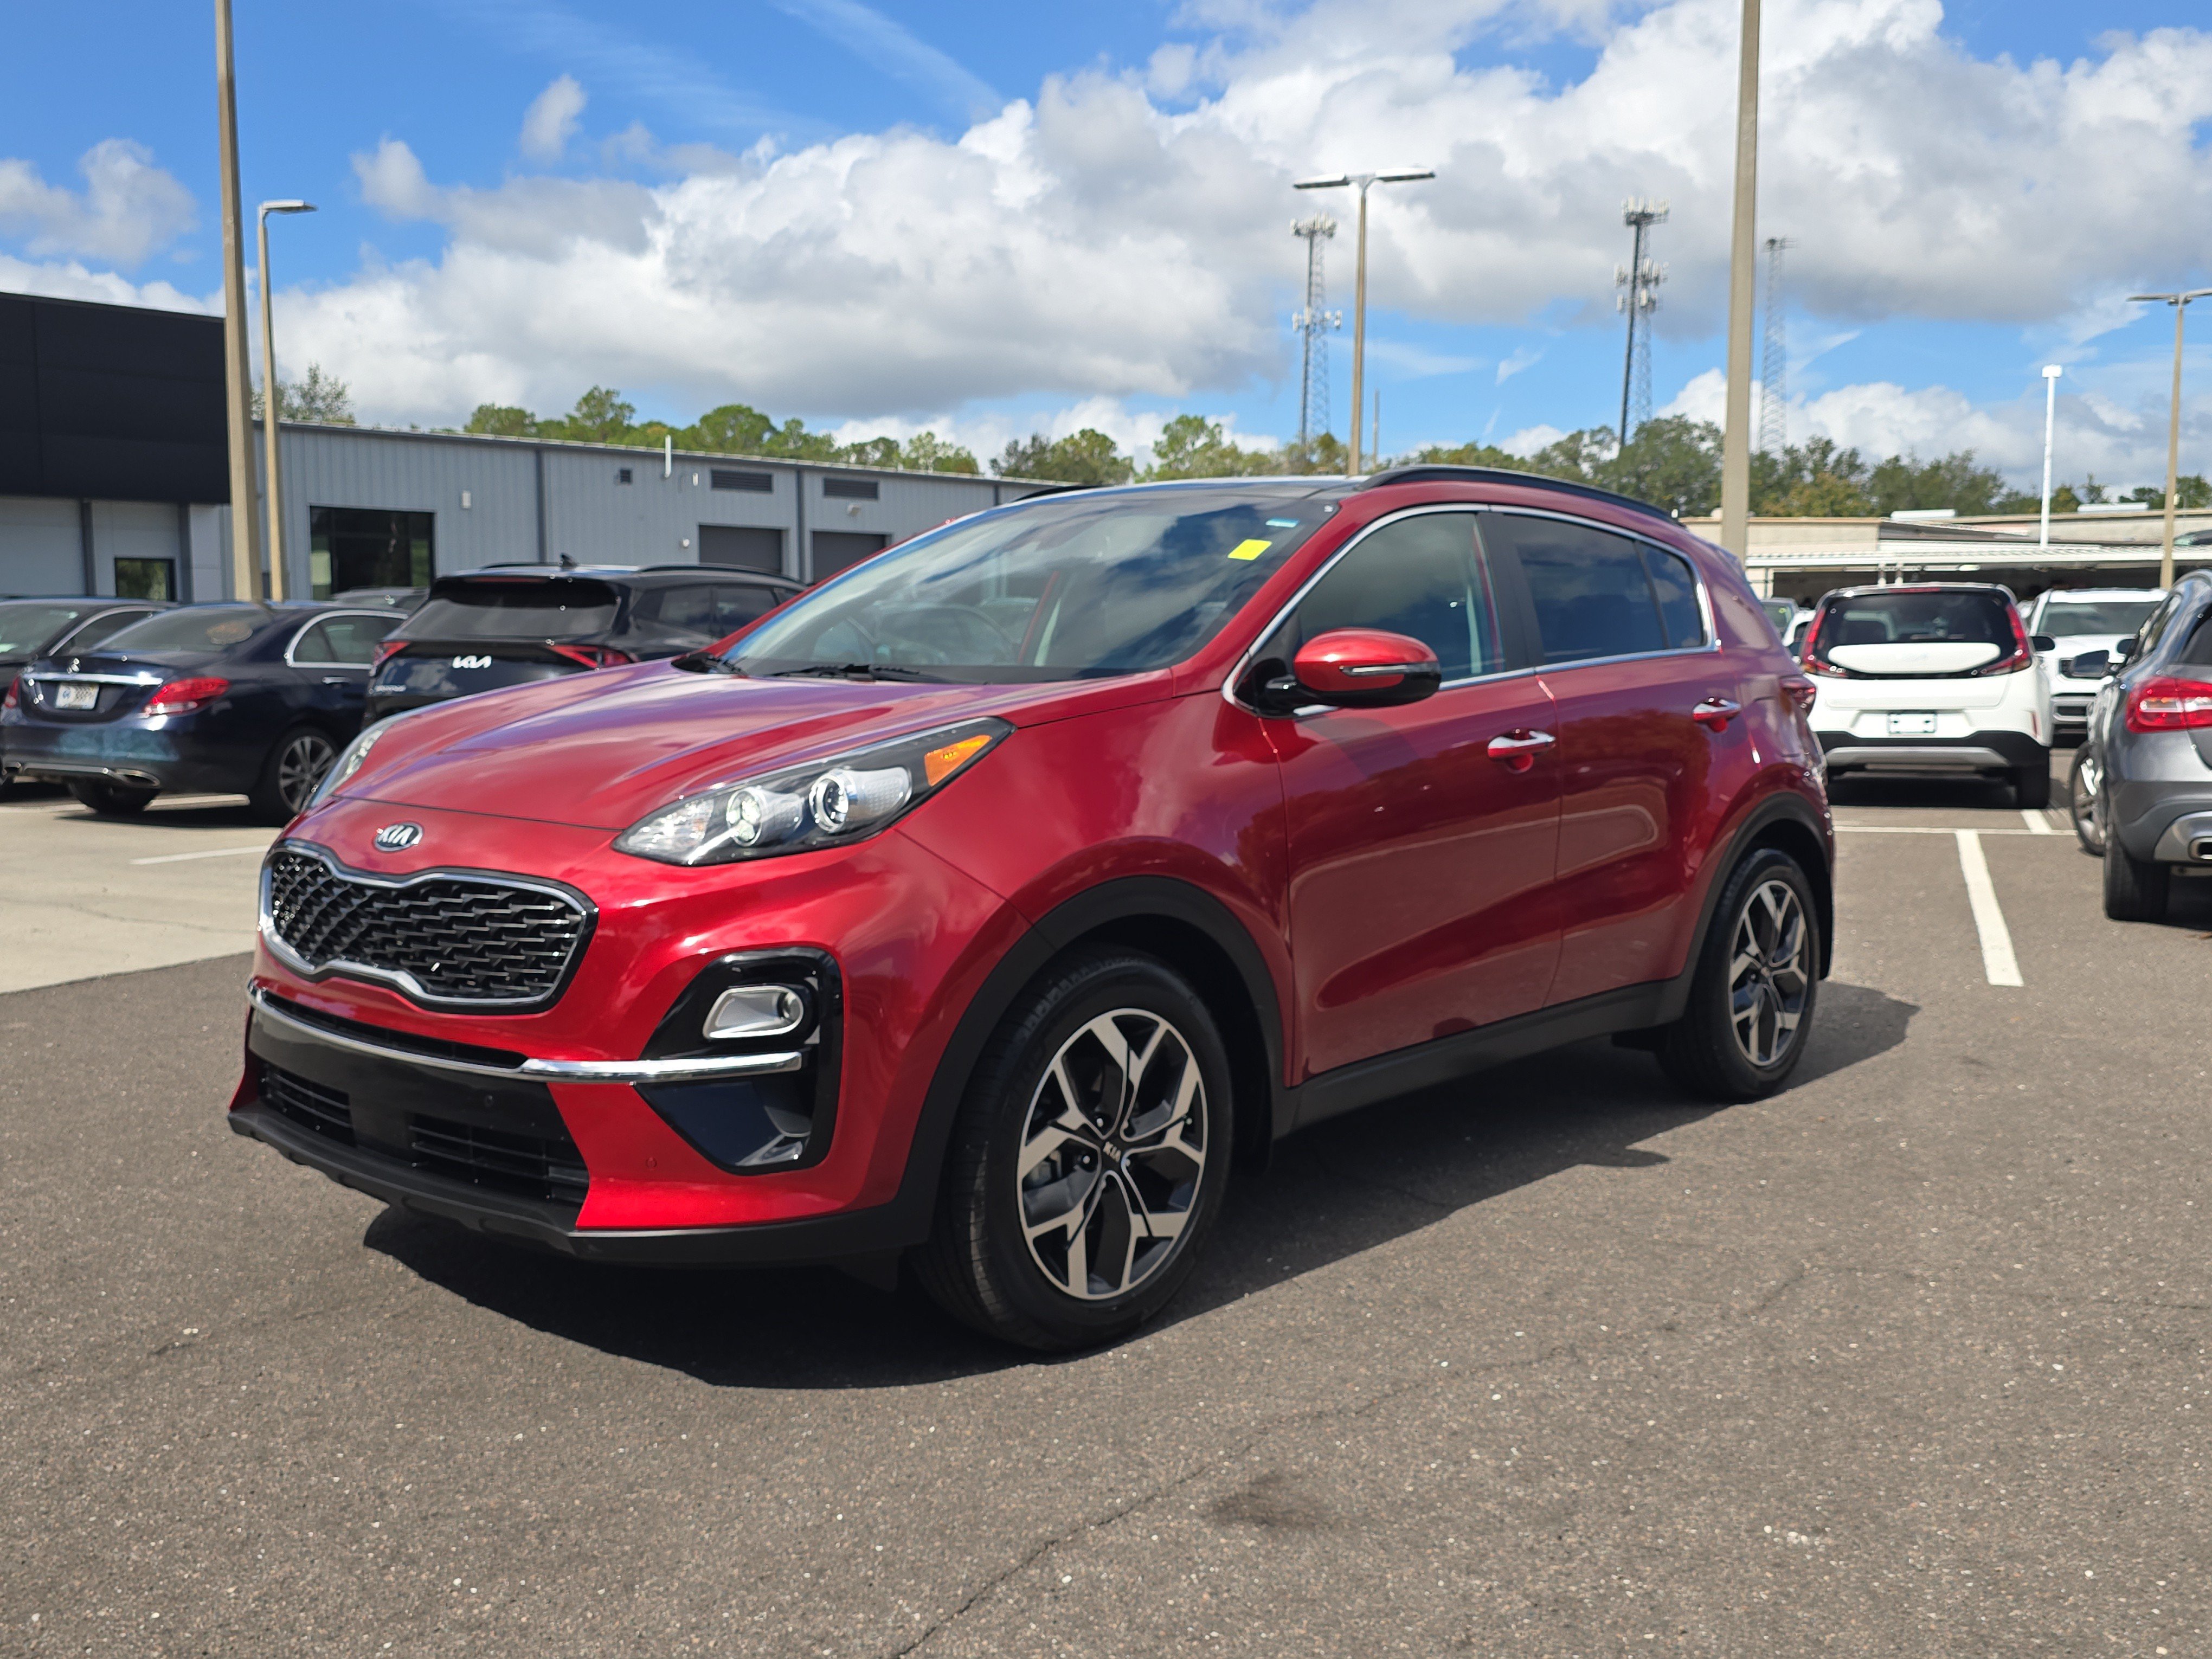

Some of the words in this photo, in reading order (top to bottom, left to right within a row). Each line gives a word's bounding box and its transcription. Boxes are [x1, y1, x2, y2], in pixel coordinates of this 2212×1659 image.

[452, 655, 492, 668] KIA
[378, 825, 414, 845] KIA
[1103, 1141, 1121, 1162] KIA
